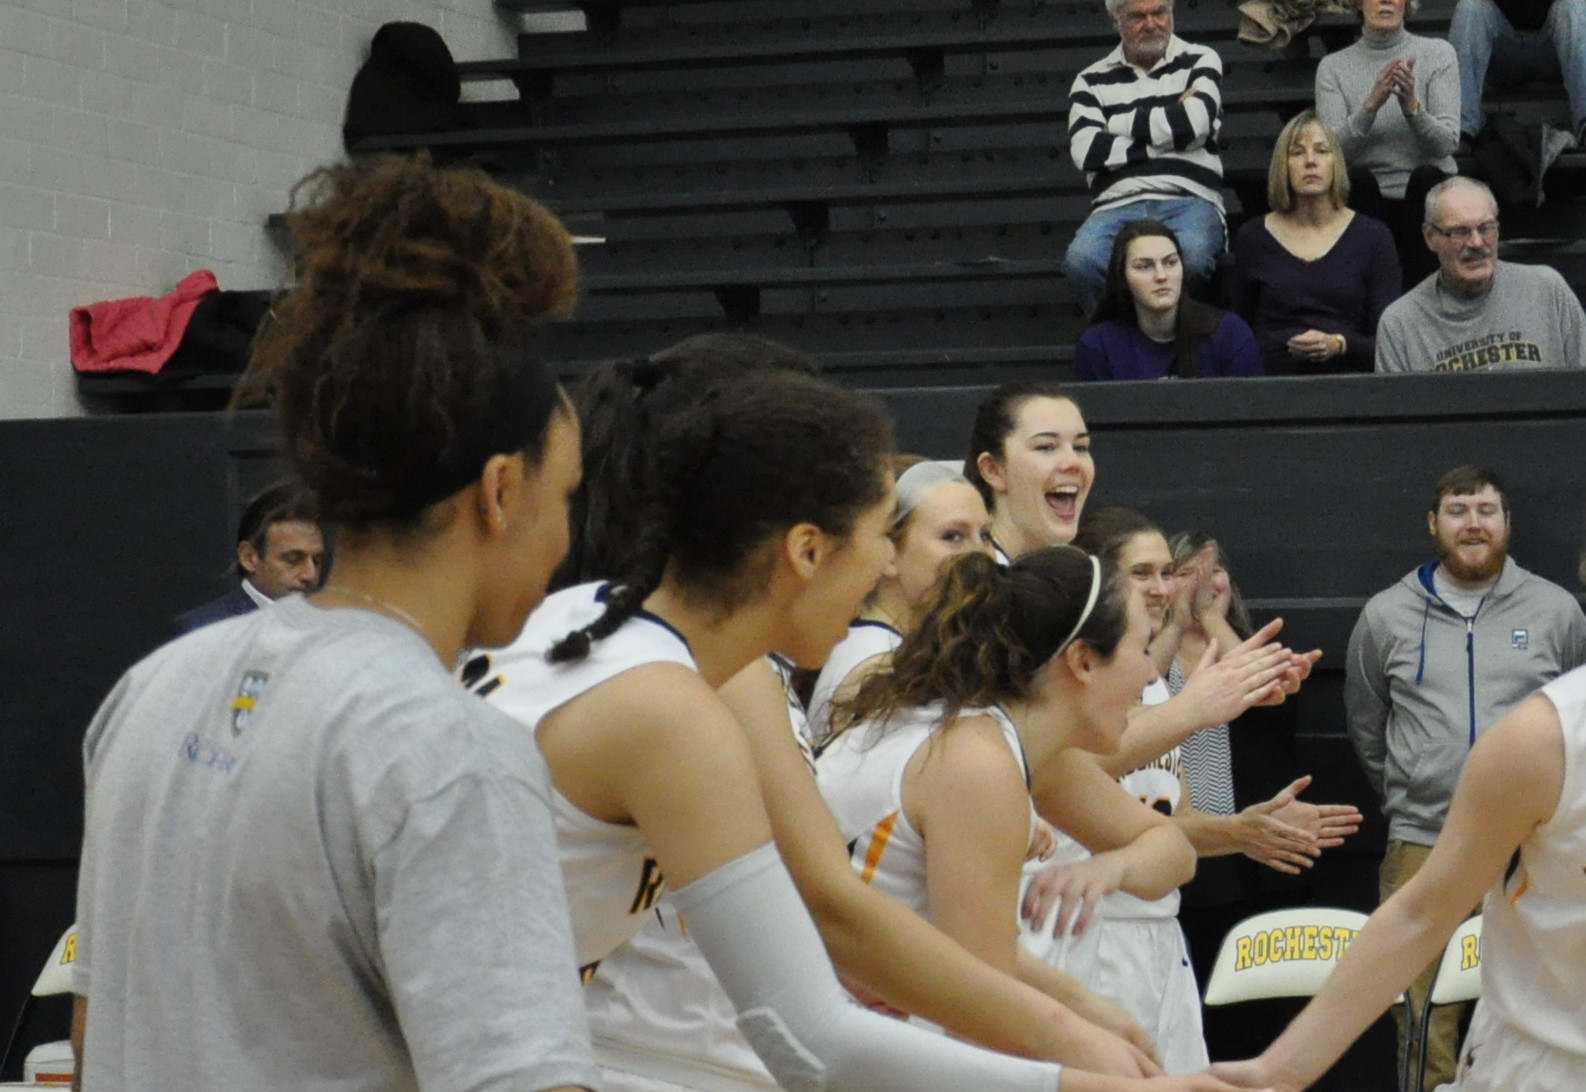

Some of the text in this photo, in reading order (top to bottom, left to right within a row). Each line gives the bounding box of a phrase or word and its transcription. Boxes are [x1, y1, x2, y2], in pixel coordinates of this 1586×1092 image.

[1436, 331, 1521, 360] UNIVERSITY OF
[1235, 925, 1361, 971] ROCHEST
